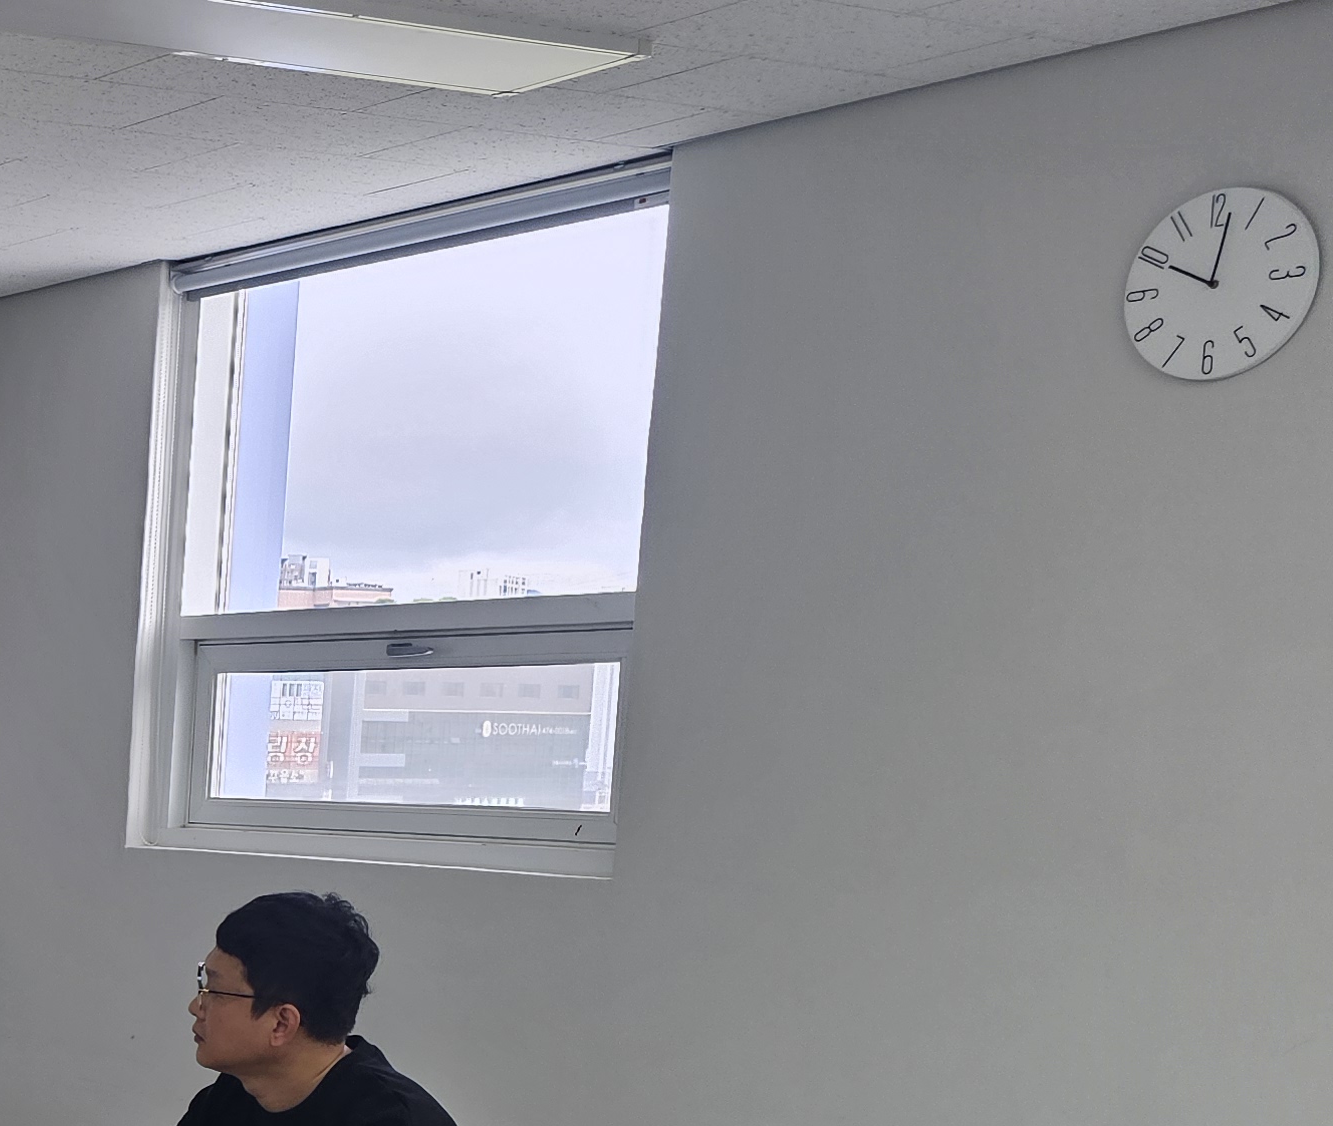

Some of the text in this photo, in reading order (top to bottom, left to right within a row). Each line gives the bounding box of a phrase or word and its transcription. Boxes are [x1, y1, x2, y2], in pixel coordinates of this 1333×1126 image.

[1210, 193, 1226, 228] 12
[1264, 223, 1297, 251] 2
[1138, 245, 1169, 270] 10
[1268, 265, 1306, 280] 3
[1126, 288, 1159, 302] 9
[1259, 304, 1290, 322] 4
[1134, 317, 1164, 342] 8
[1233, 325, 1257, 357] 5
[1162, 335, 1185, 368] 7
[1201, 340, 1214, 375] 6
